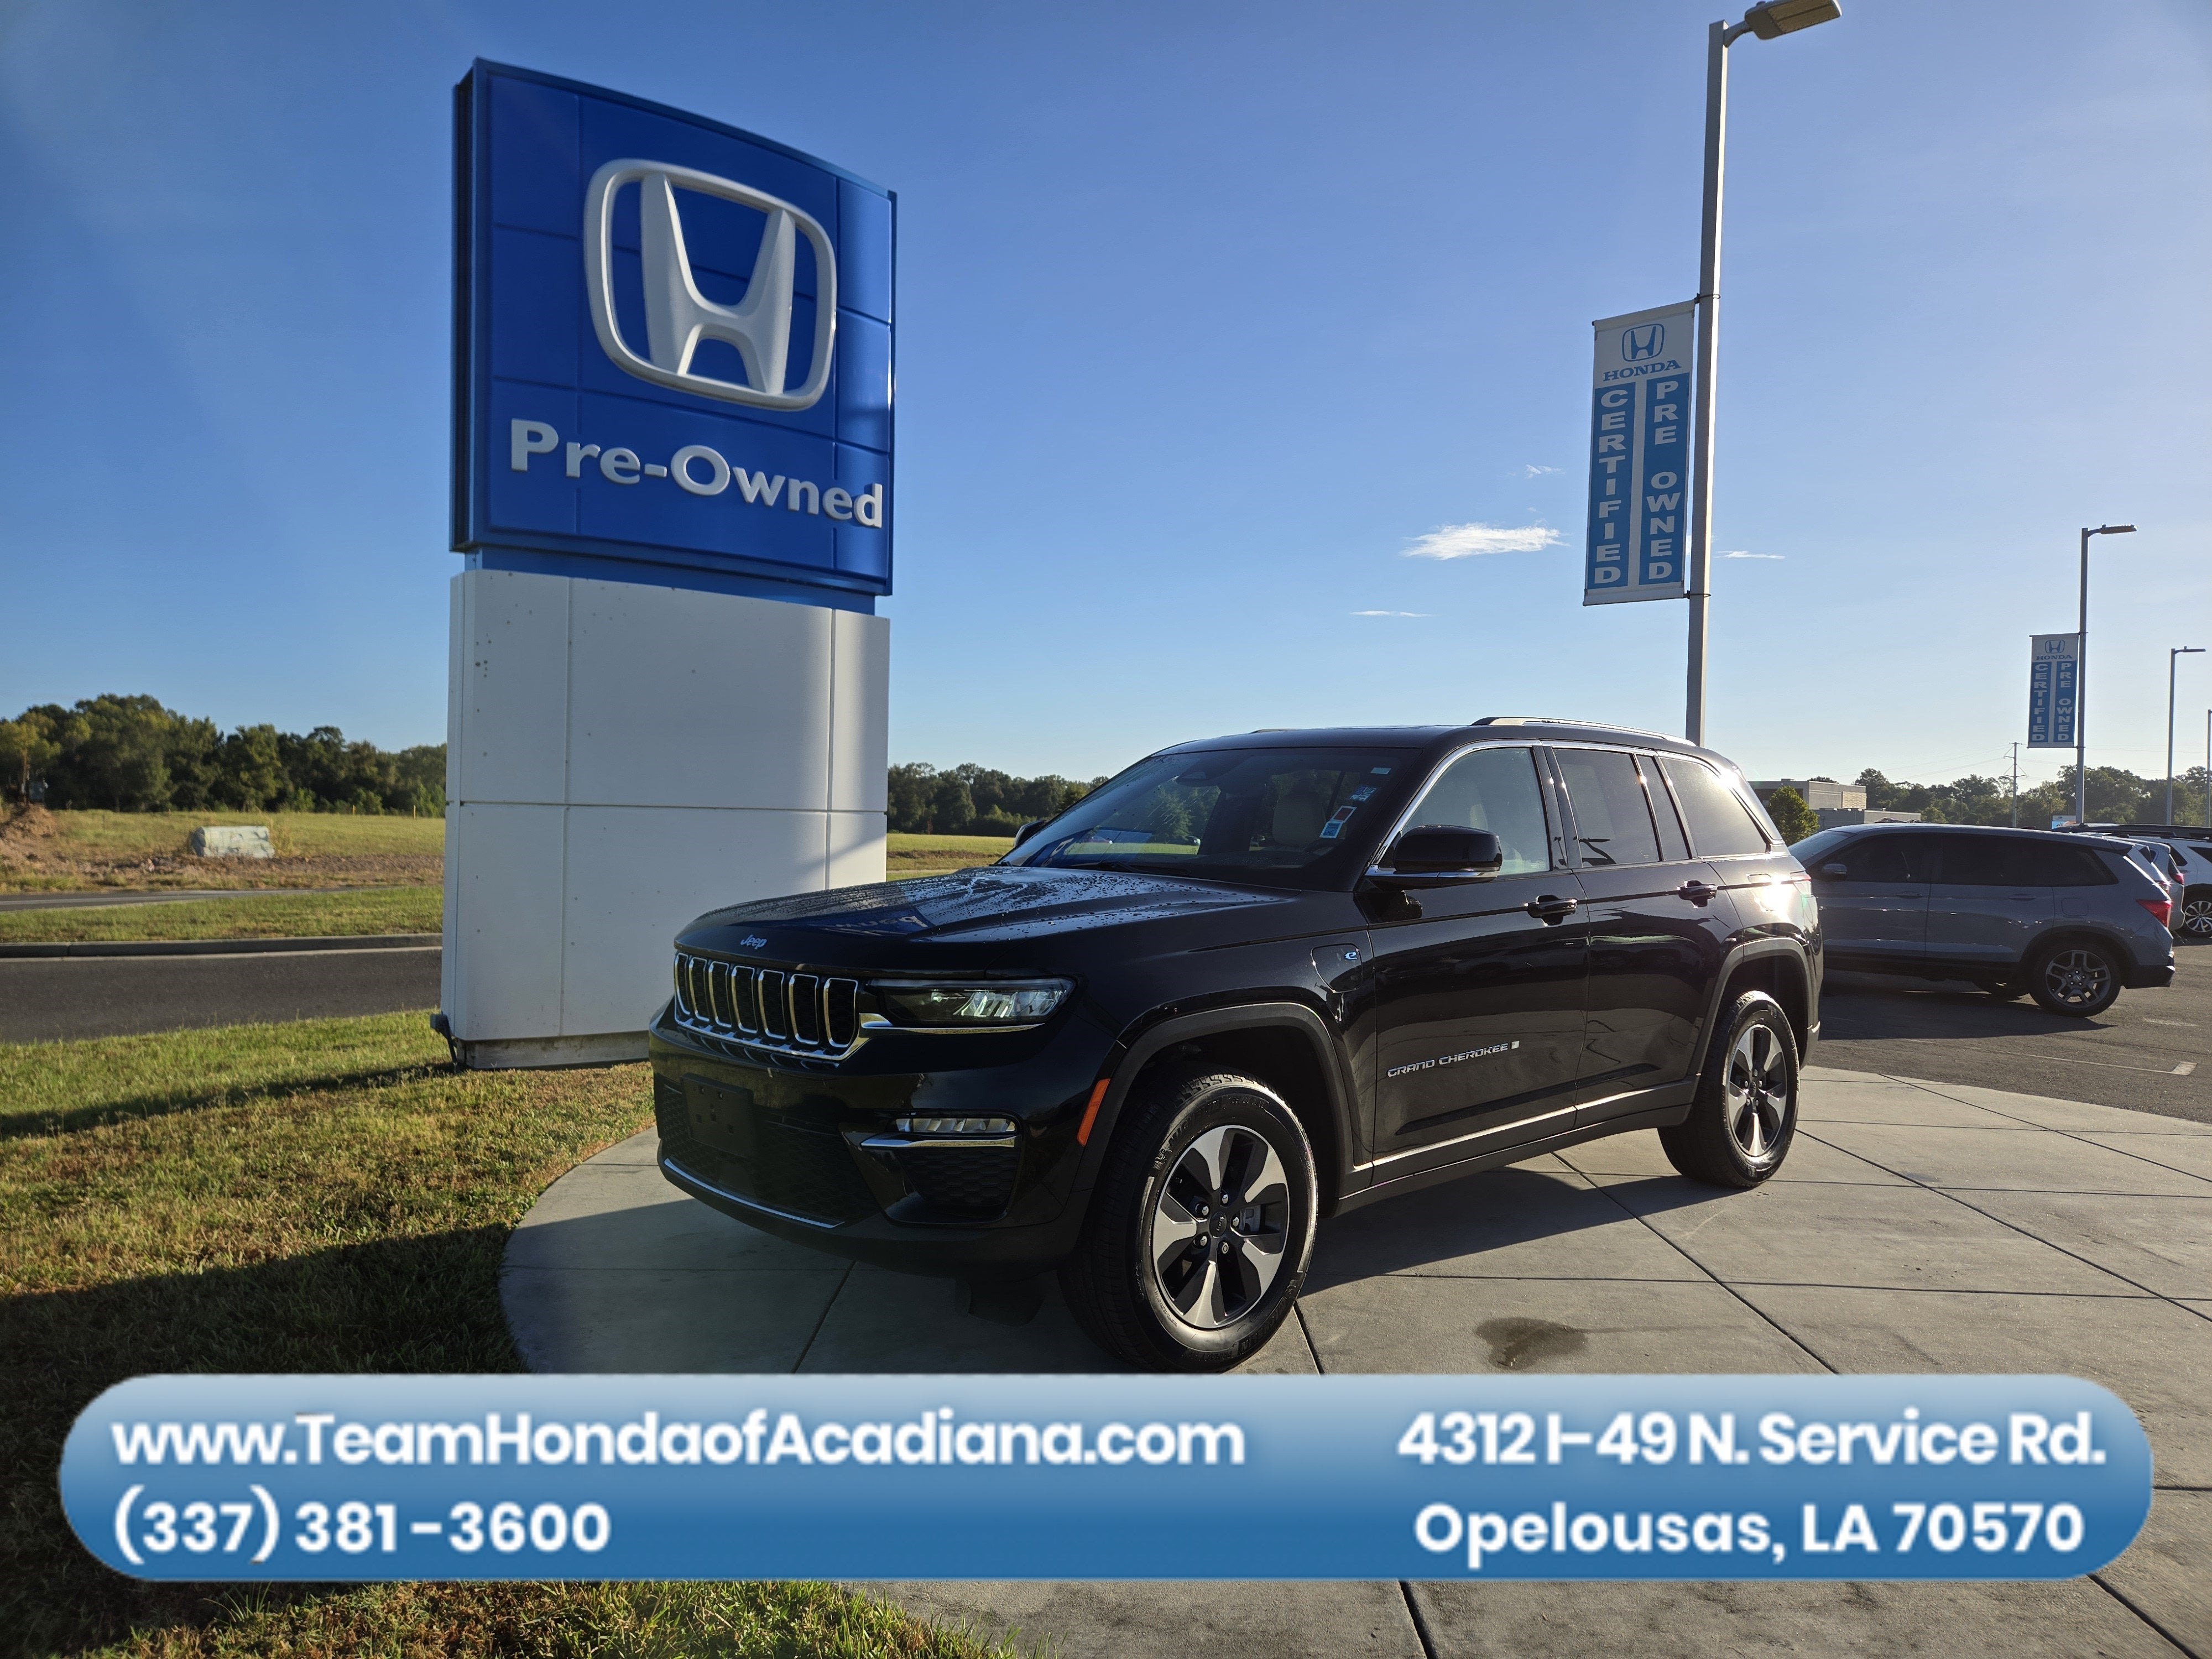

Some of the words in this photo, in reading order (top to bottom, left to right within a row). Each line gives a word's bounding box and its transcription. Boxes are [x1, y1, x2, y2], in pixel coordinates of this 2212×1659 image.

[1604, 359, 1681, 381] HONDA
[1654, 380, 1678, 445] PRE
[510, 418, 883, 529] Pre-Owned
[1594, 389, 1629, 584] CERTIFIED
[1646, 472, 1681, 580] OWNED
[2060, 663, 2072, 687] PRE
[2032, 664, 2048, 741] CERTIFIED
[2056, 698, 2073, 741] OWNED
[740, 934, 767, 950] Jeep
[1387, 1060, 1436, 1077] GRAND
[1438, 1043, 1509, 1066] CHEROKEE
